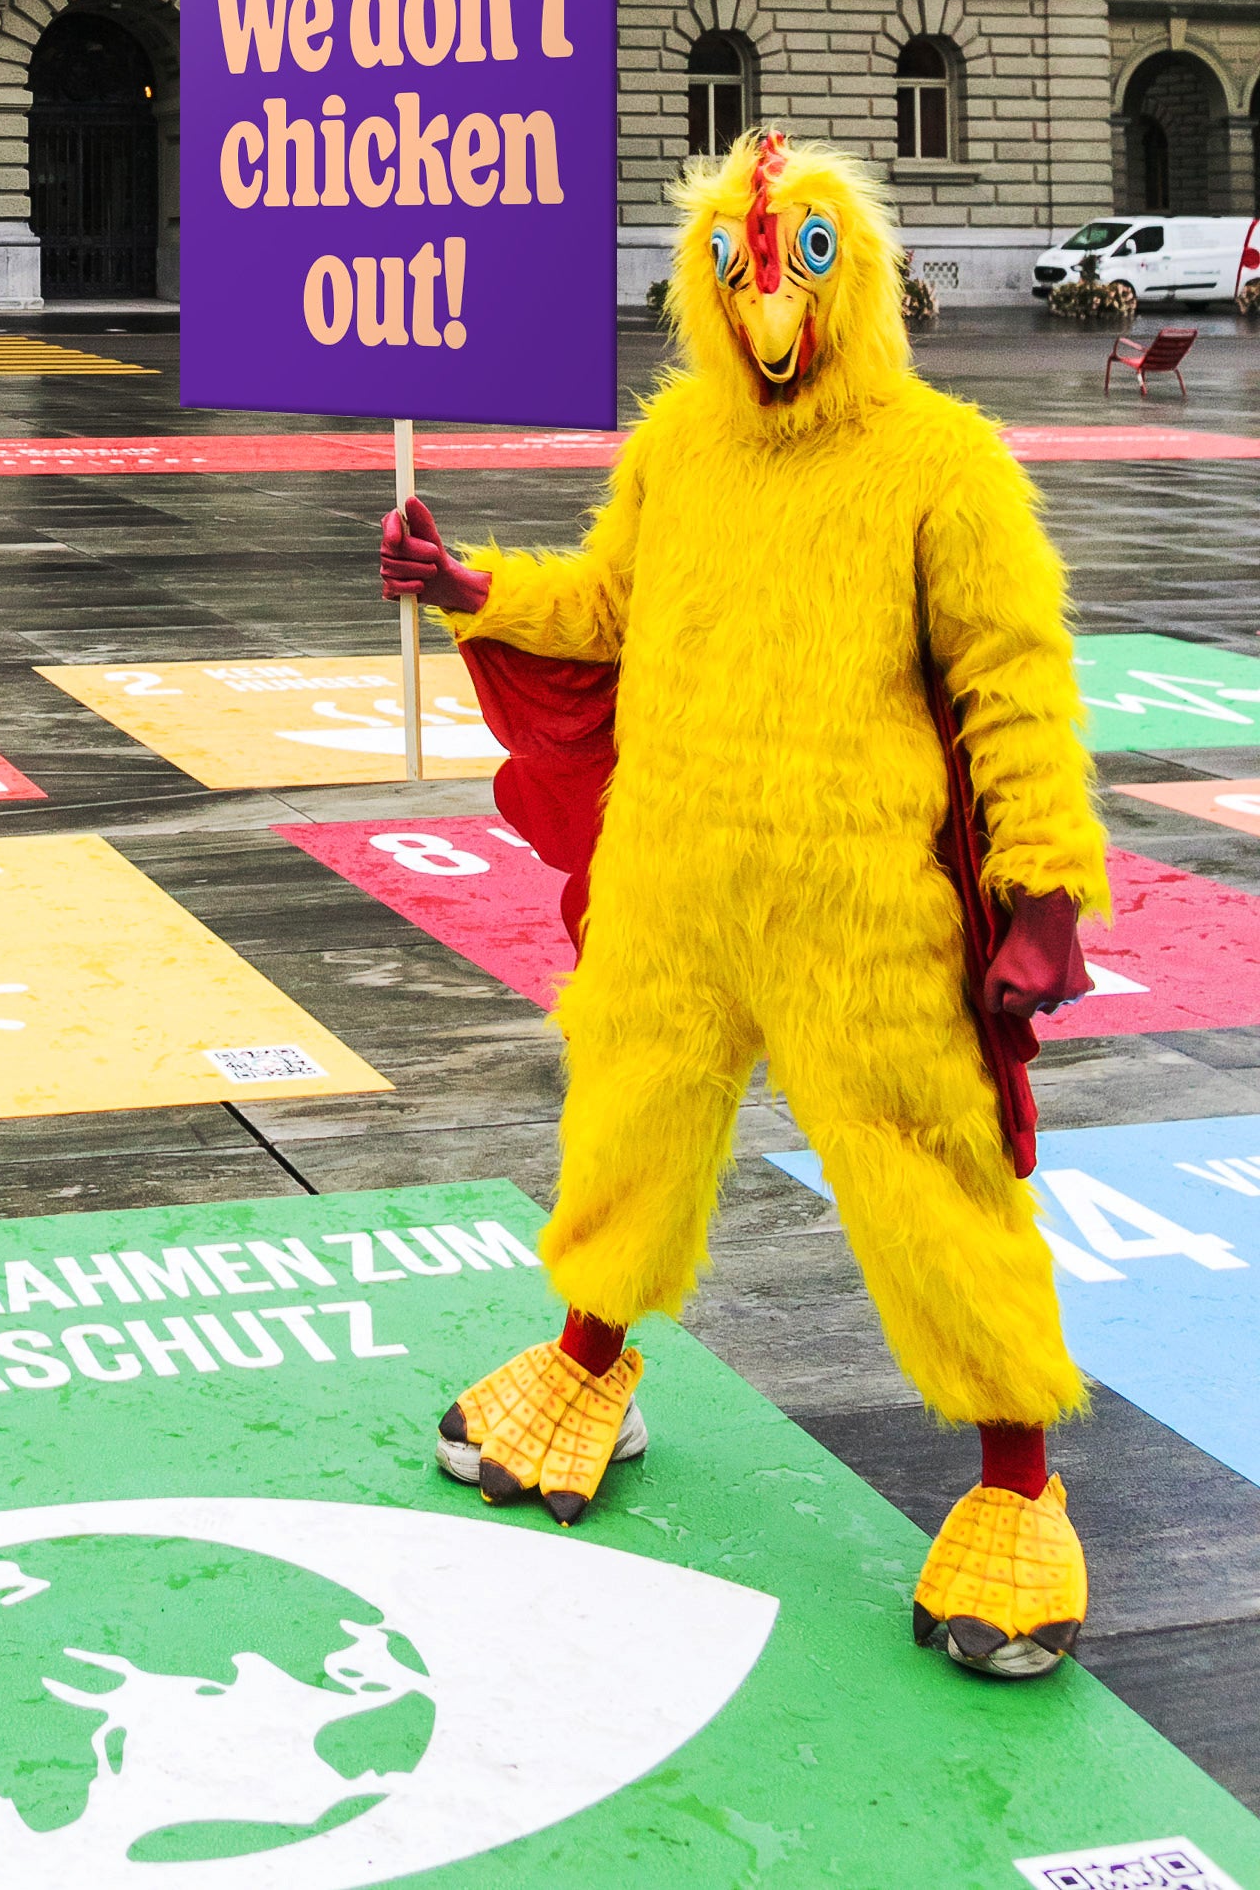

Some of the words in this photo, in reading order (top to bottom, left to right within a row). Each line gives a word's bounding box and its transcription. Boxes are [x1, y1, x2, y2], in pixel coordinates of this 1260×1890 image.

[220, 92, 565, 209] chicken
[303, 237, 468, 350] out!
[103, 670, 184, 696] 2
[202, 665, 303, 681] KEIN
[222, 674, 400, 693] HUNGER
[368, 832, 491, 877] 8
[321, 1220, 544, 1284] ZUM
